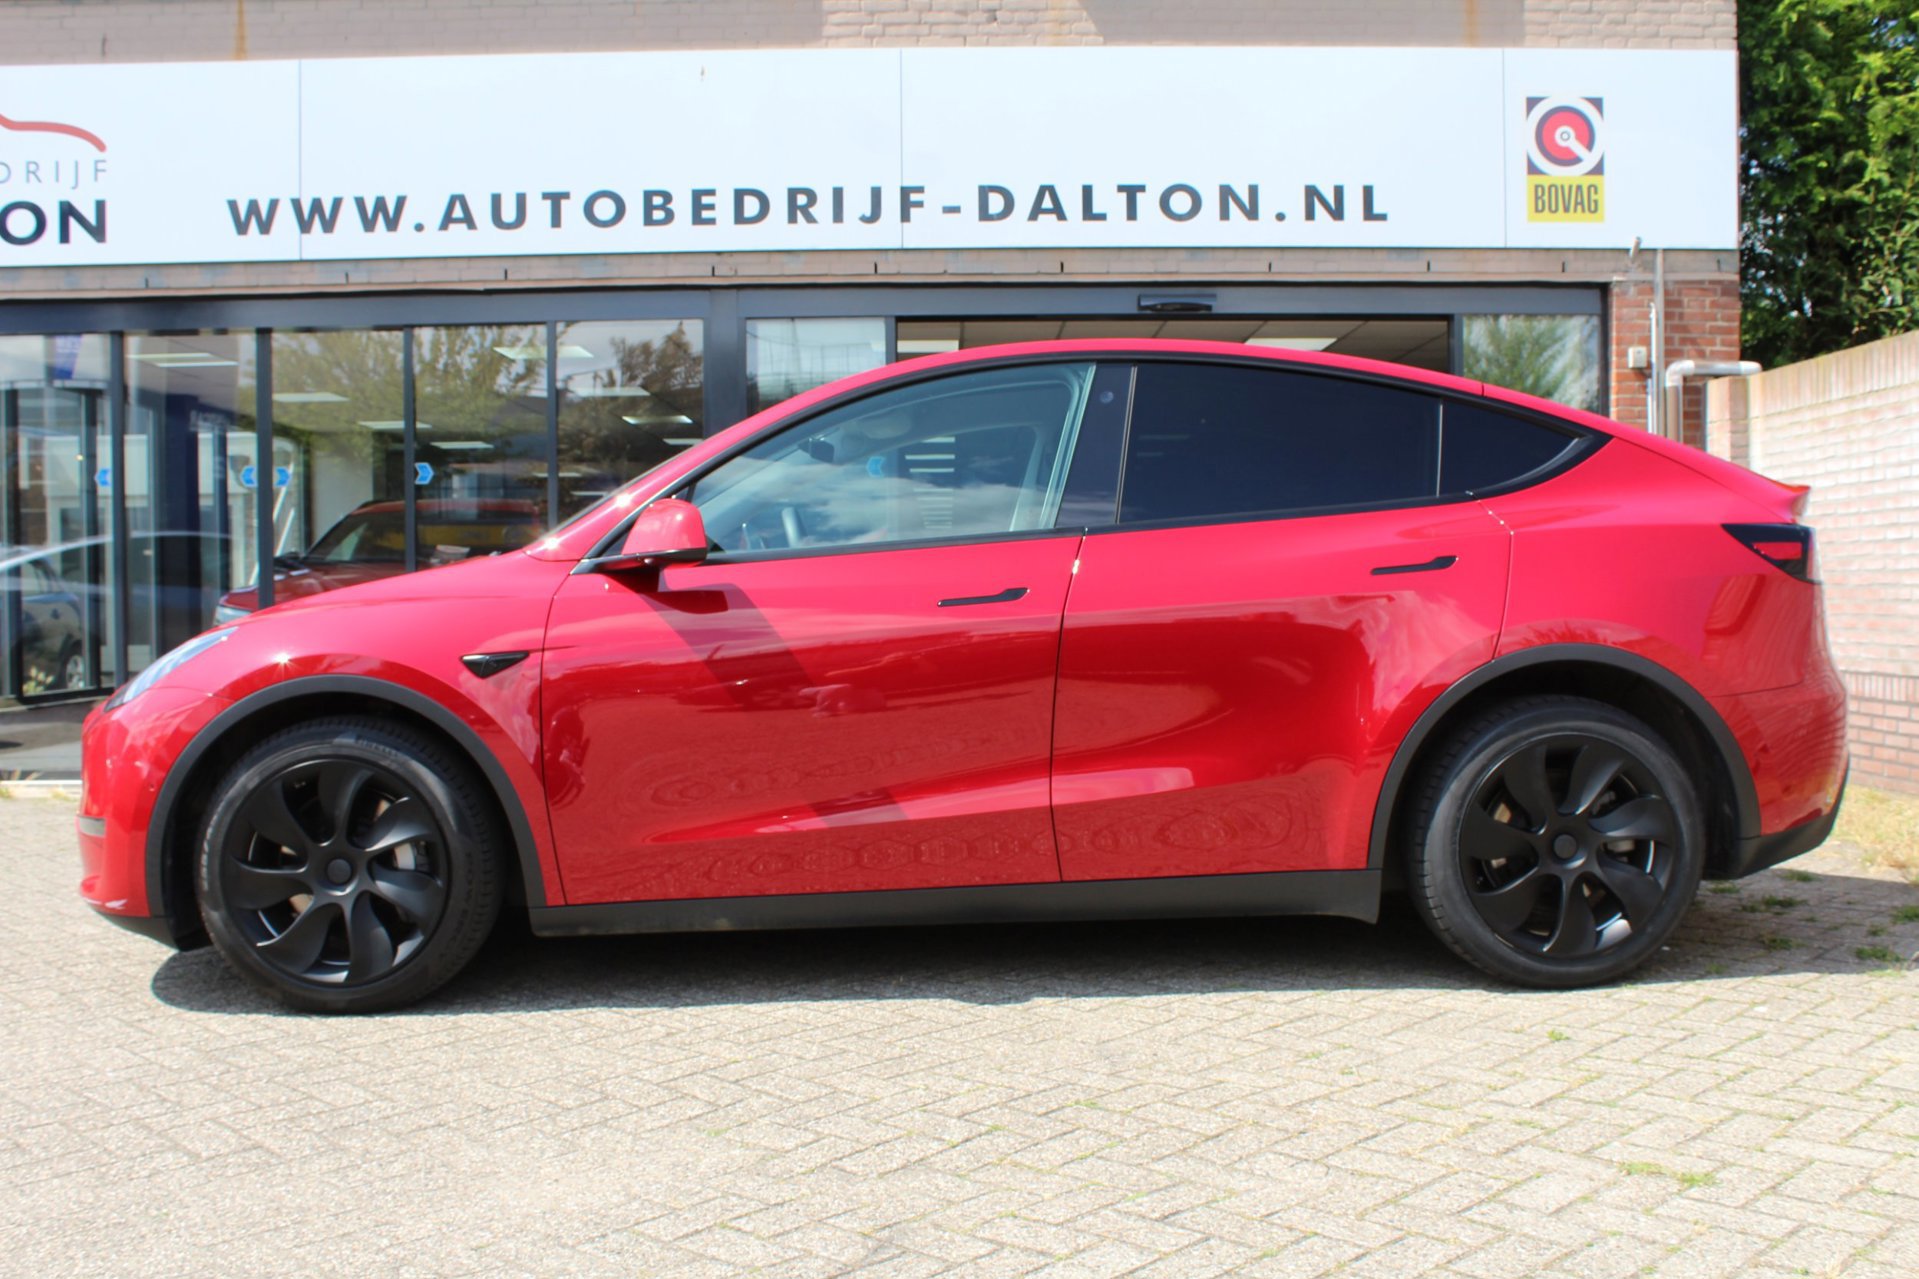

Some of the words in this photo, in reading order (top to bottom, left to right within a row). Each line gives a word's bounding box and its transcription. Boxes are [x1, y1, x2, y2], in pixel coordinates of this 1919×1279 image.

[226, 183, 1389, 236] WWW.AUTOBEDRIJF-DALTON.NL
[1534, 183, 1599, 214] BOVAG
[0, 199, 107, 246] ON
